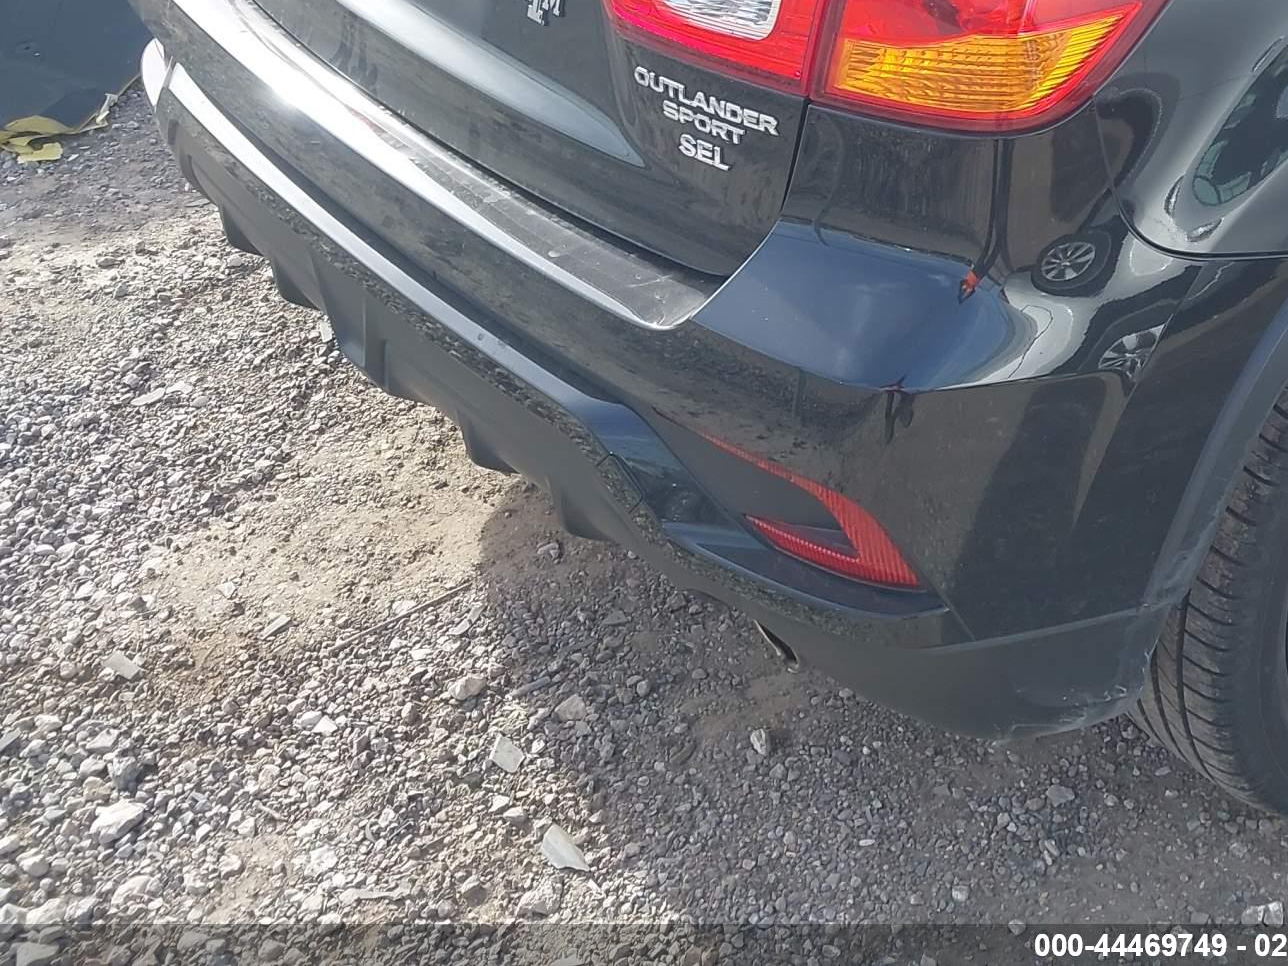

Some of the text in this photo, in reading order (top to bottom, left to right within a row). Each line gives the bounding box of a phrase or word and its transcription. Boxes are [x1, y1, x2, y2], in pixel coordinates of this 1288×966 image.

[634, 66, 779, 135] OUTLANDER
[663, 99, 745, 144] SPORT
[679, 133, 731, 171] SEL
